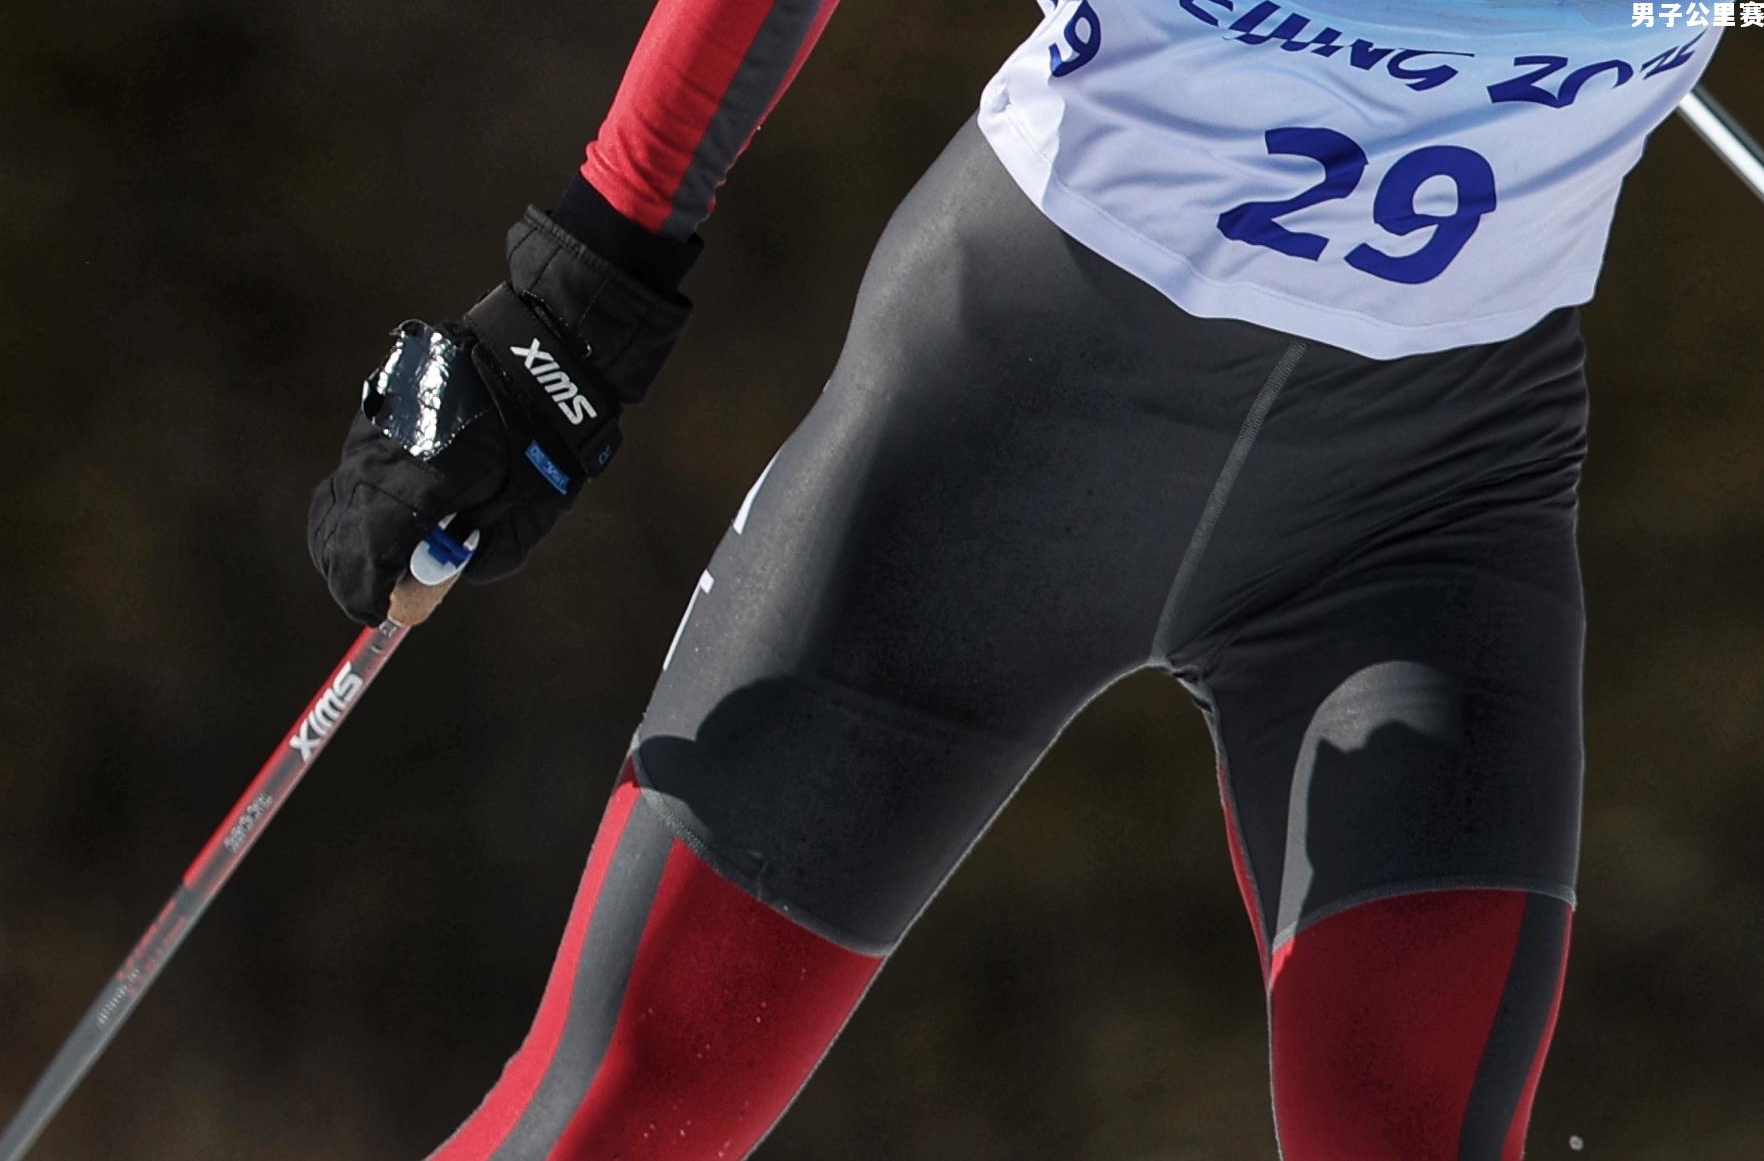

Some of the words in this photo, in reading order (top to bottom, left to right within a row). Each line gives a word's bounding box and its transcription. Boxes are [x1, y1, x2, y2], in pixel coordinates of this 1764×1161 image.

[1217, 126, 1497, 284] 29
[510, 338, 598, 426] SWIX
[289, 660, 364, 762] SWIX
